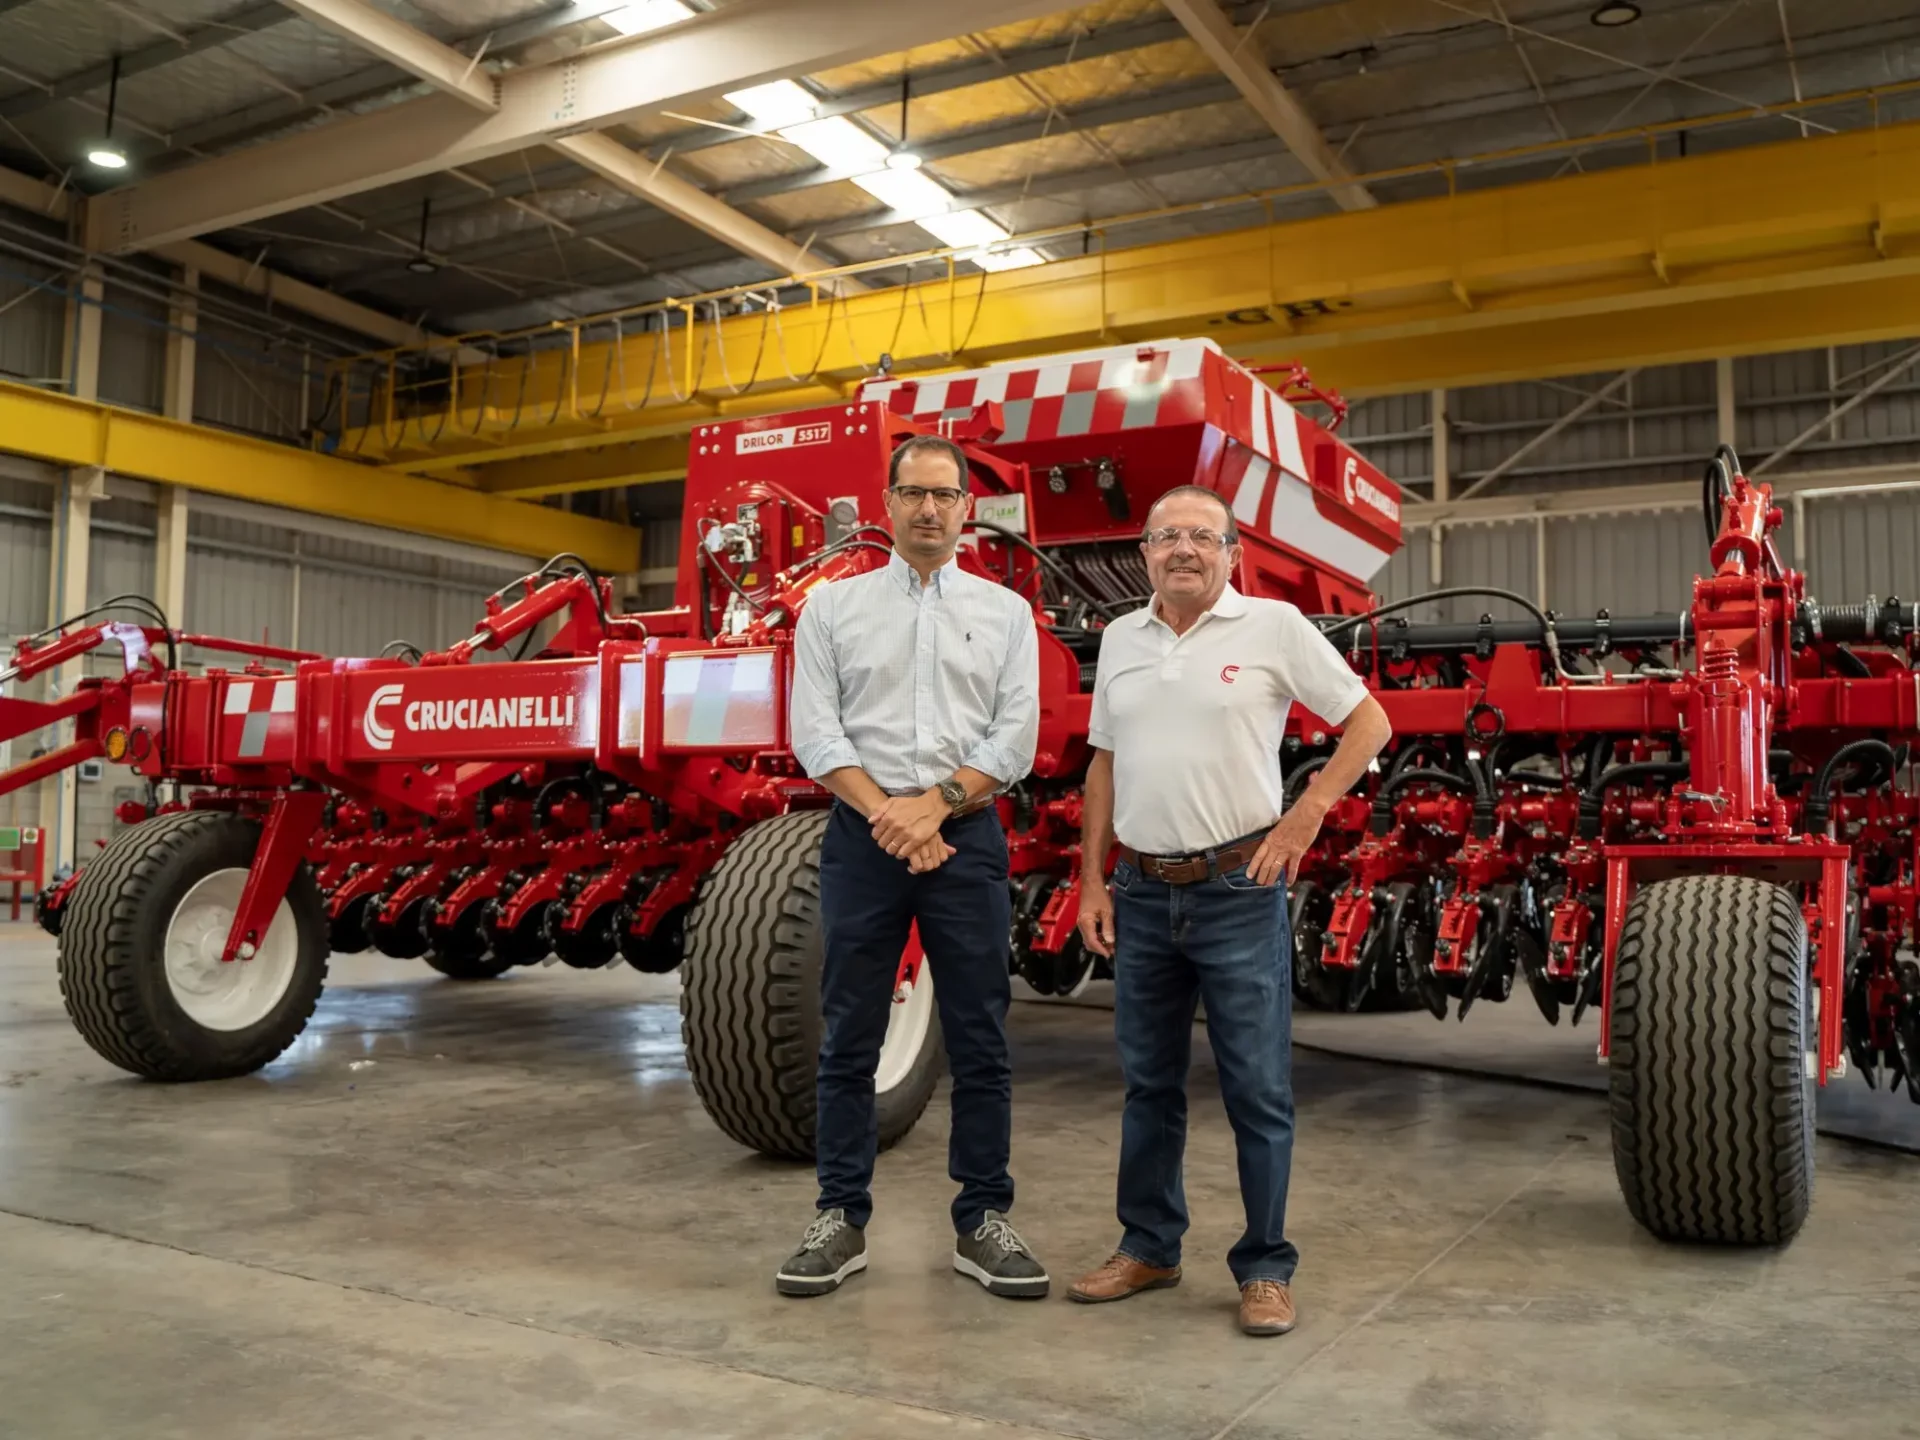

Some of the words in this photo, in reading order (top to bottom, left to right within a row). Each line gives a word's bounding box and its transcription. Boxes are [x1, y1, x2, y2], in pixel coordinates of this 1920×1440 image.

[743, 433, 784, 449] DRILOR
[798, 426, 828, 442] 5517
[405, 695, 574, 731] CRUCIANELLI
